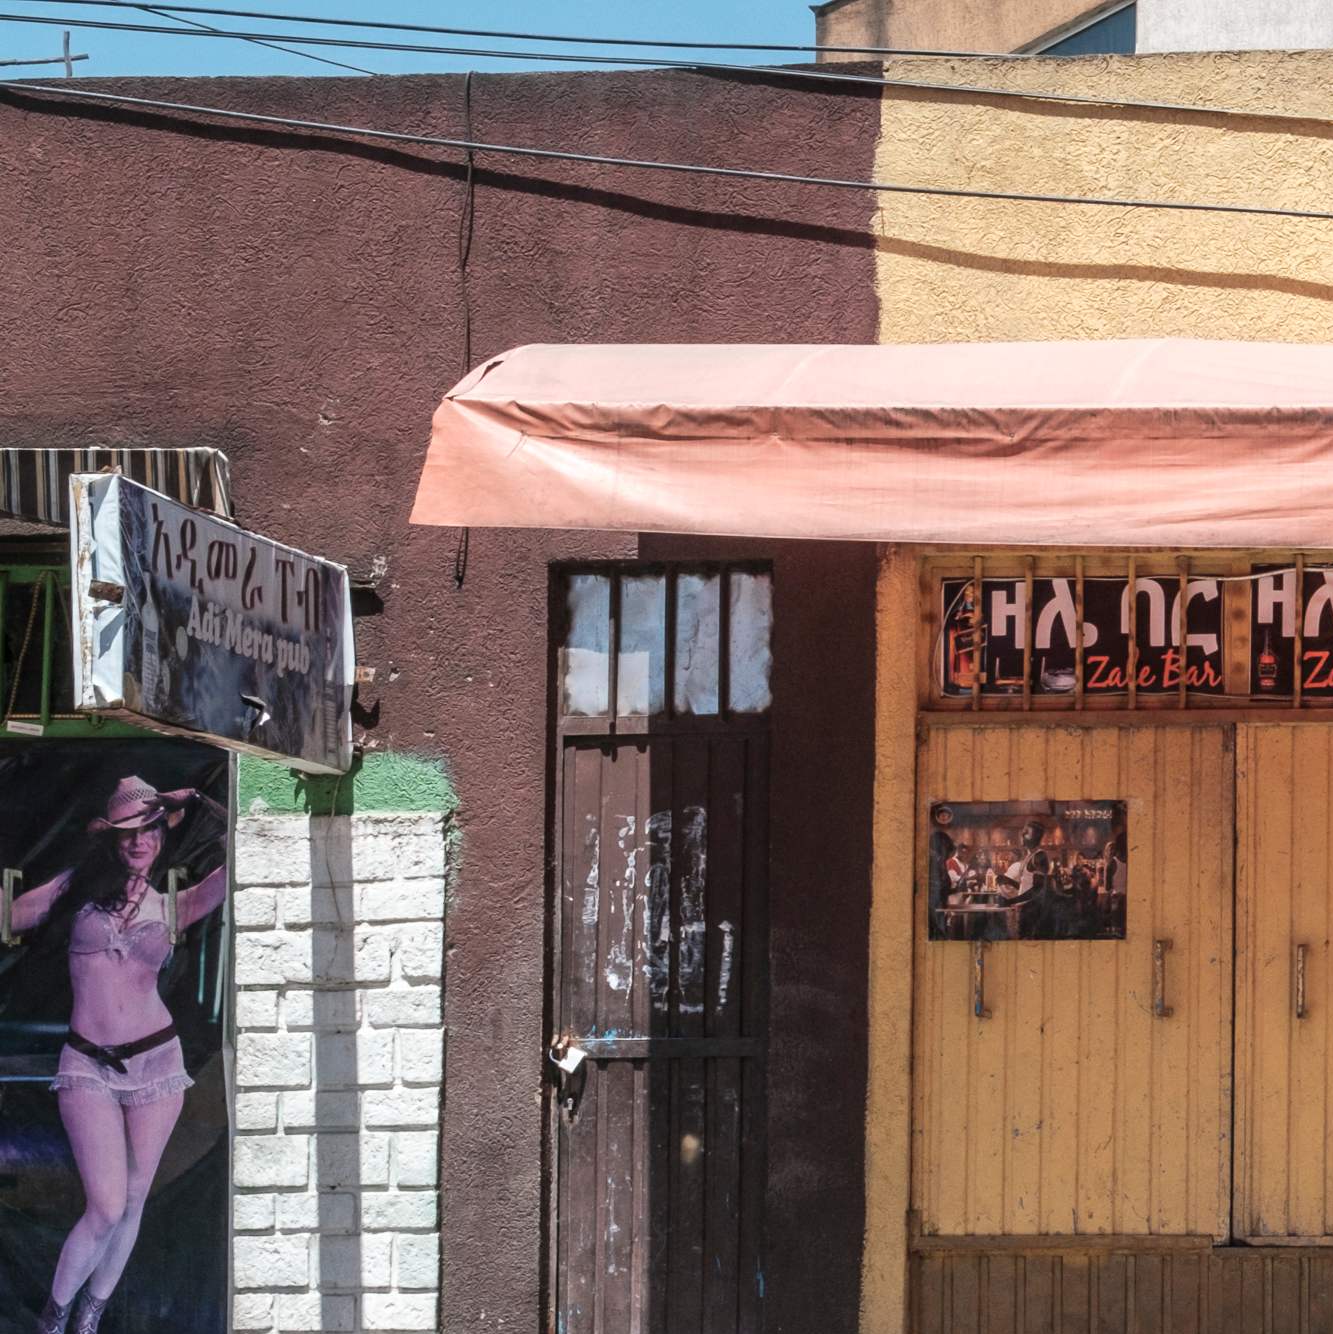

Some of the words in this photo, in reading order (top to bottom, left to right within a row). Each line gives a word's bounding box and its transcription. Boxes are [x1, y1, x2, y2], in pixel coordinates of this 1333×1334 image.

[187, 595, 221, 645] Adi
[225, 609, 274, 664] Mera
[275, 635, 311, 679] pub
[1120, 578, 1219, 656] ባር
[1161, 648, 1222, 688] Bar
